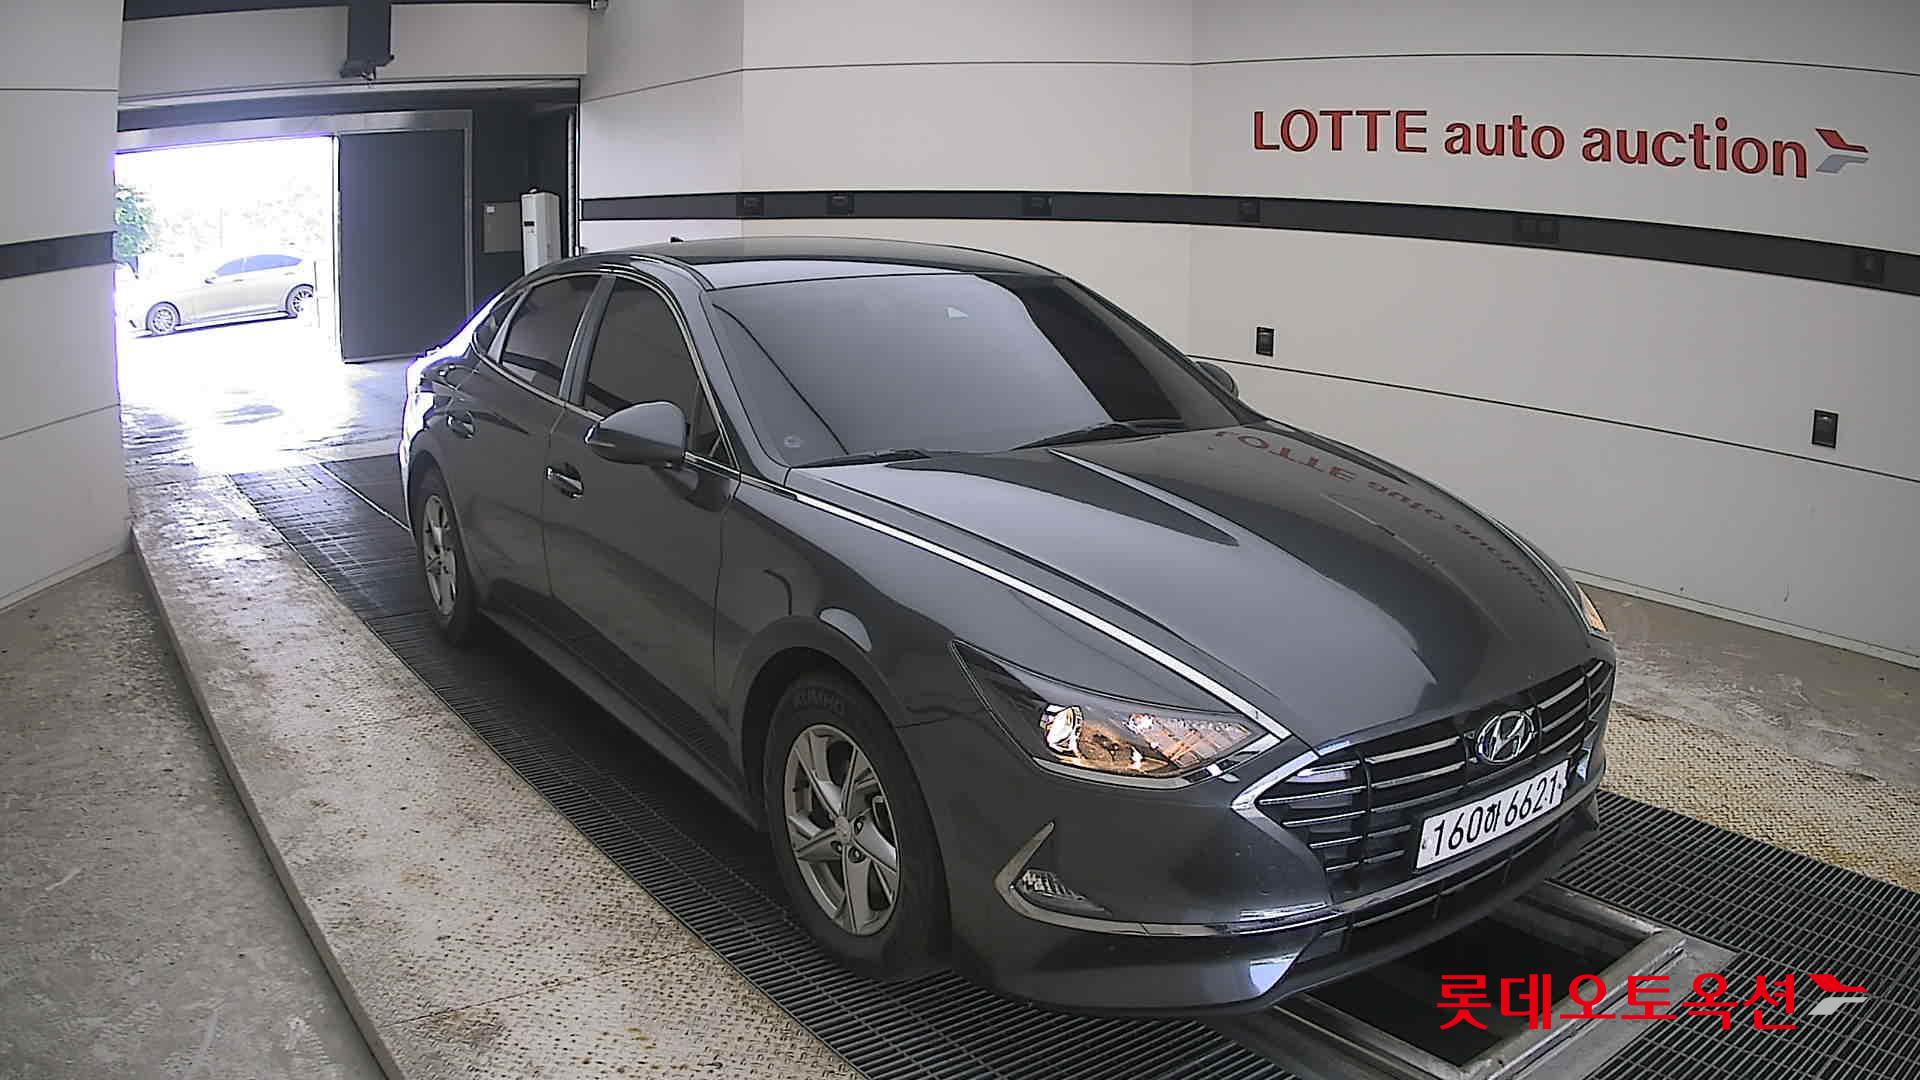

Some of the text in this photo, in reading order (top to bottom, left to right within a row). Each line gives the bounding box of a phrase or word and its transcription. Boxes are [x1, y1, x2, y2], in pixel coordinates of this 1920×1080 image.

[1253, 109, 1808, 179] LOTTE auto auction
